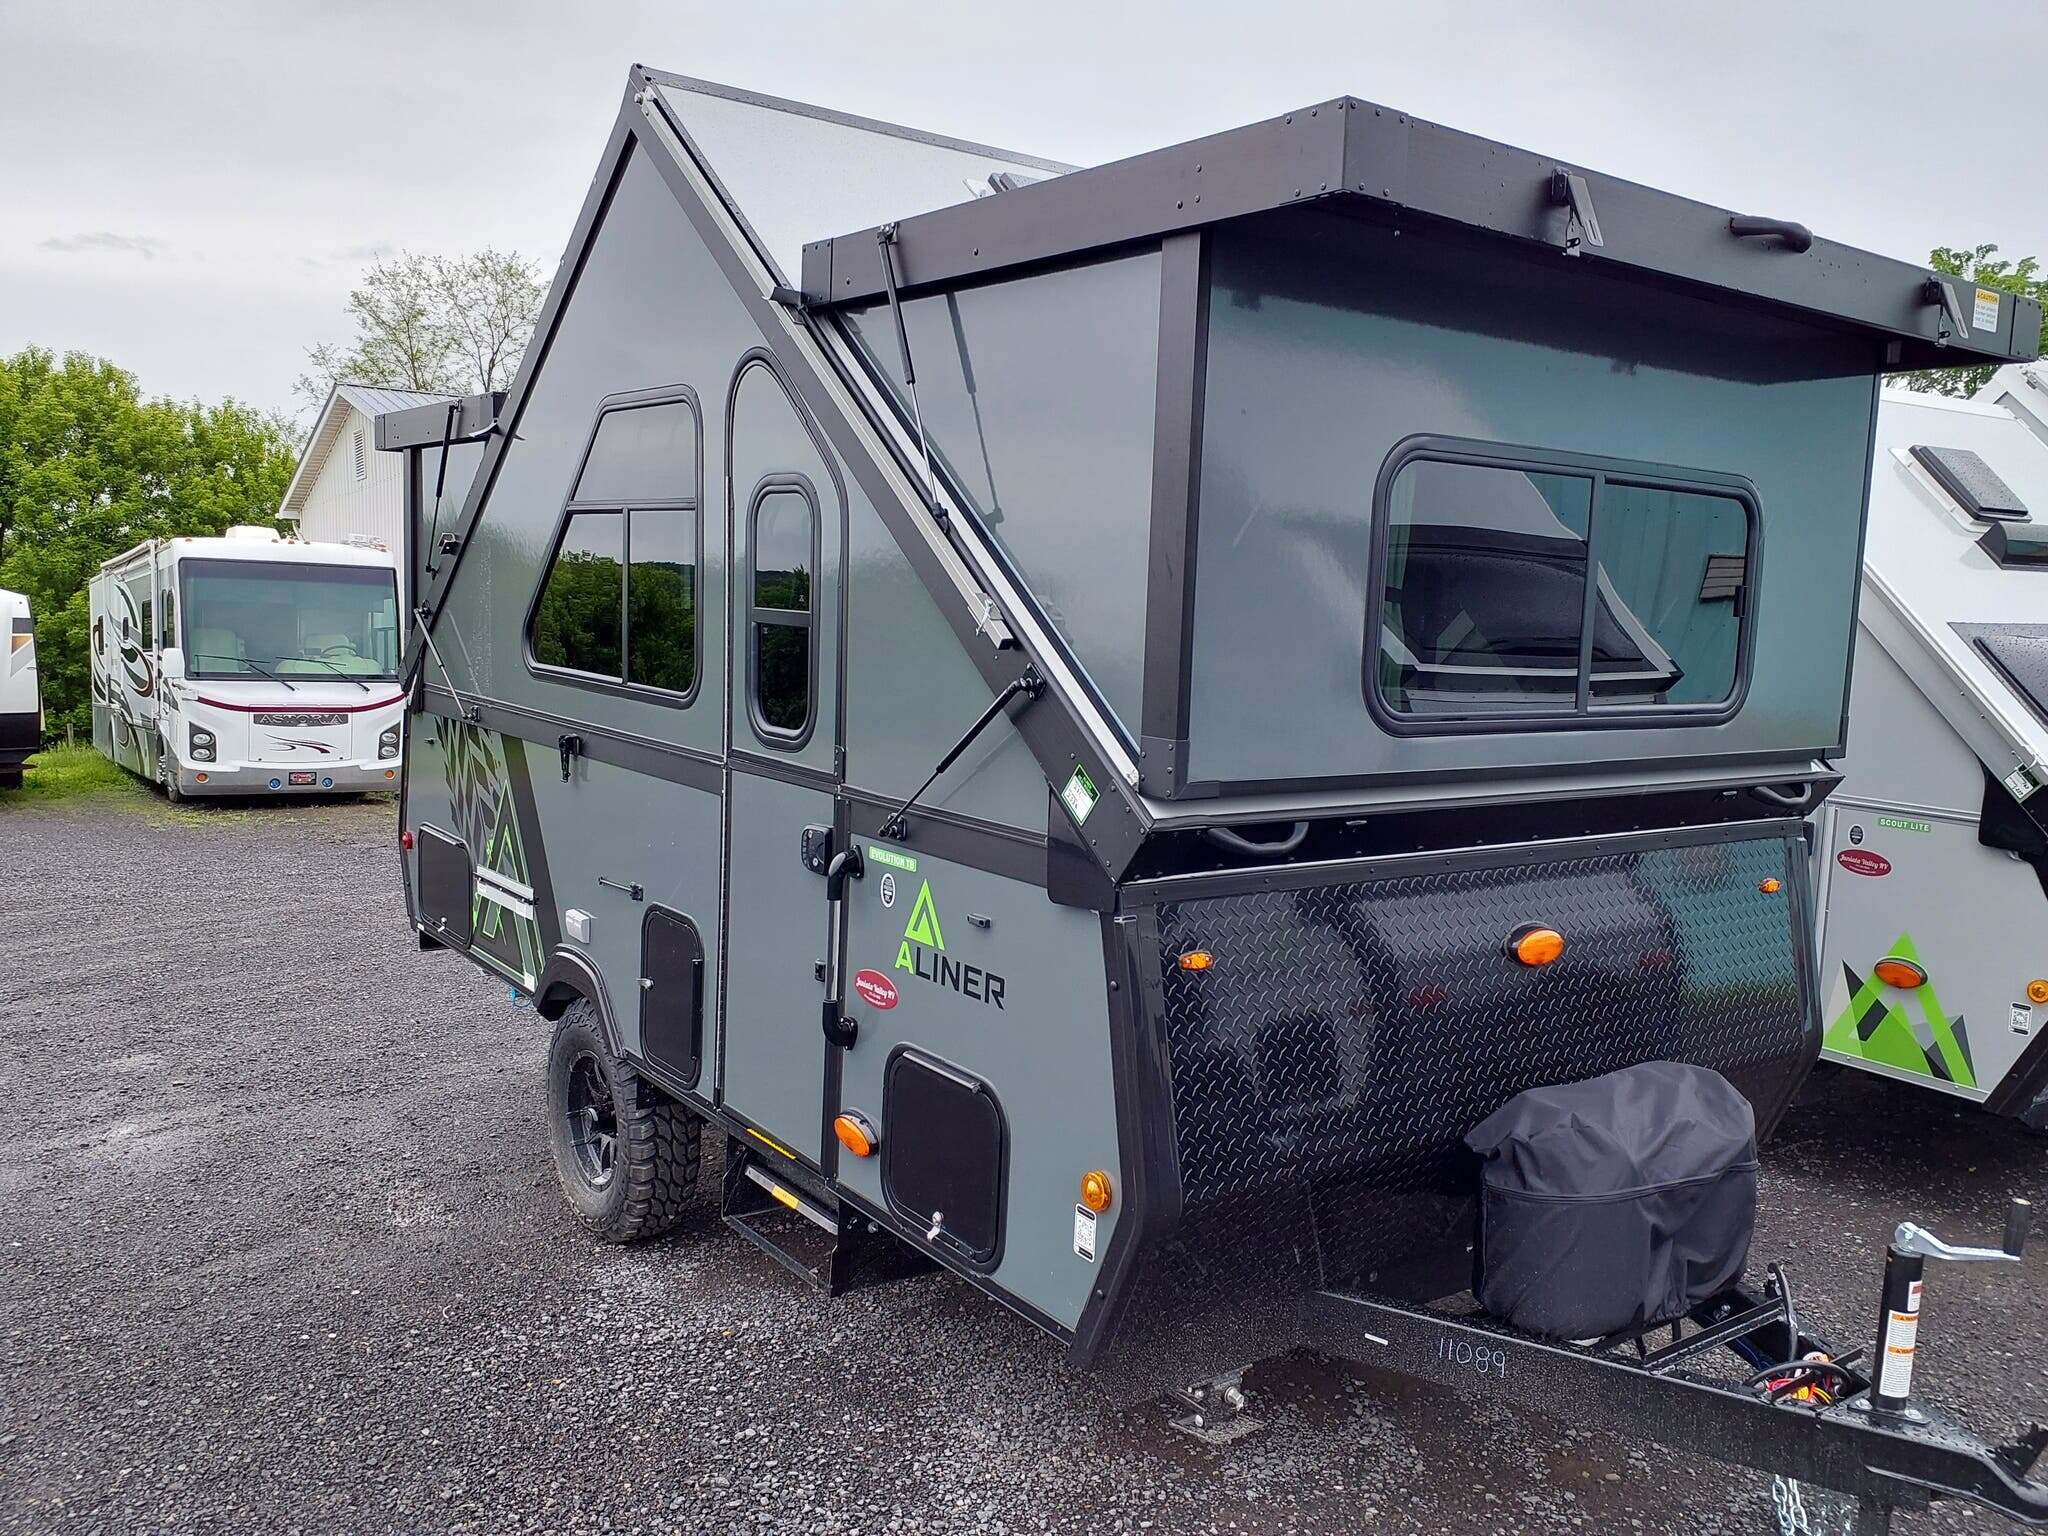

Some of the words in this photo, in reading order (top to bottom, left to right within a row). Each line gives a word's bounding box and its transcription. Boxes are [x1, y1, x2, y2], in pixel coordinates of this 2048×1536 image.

[260, 713, 343, 724] ASTORIA
[1880, 818, 1908, 828] SCOUT
[1910, 822, 1930, 832] LITE
[871, 848, 905, 867] EVOLUTION
[895, 941, 1006, 1010] ALINER
[1439, 1338, 1506, 1378] 11089
